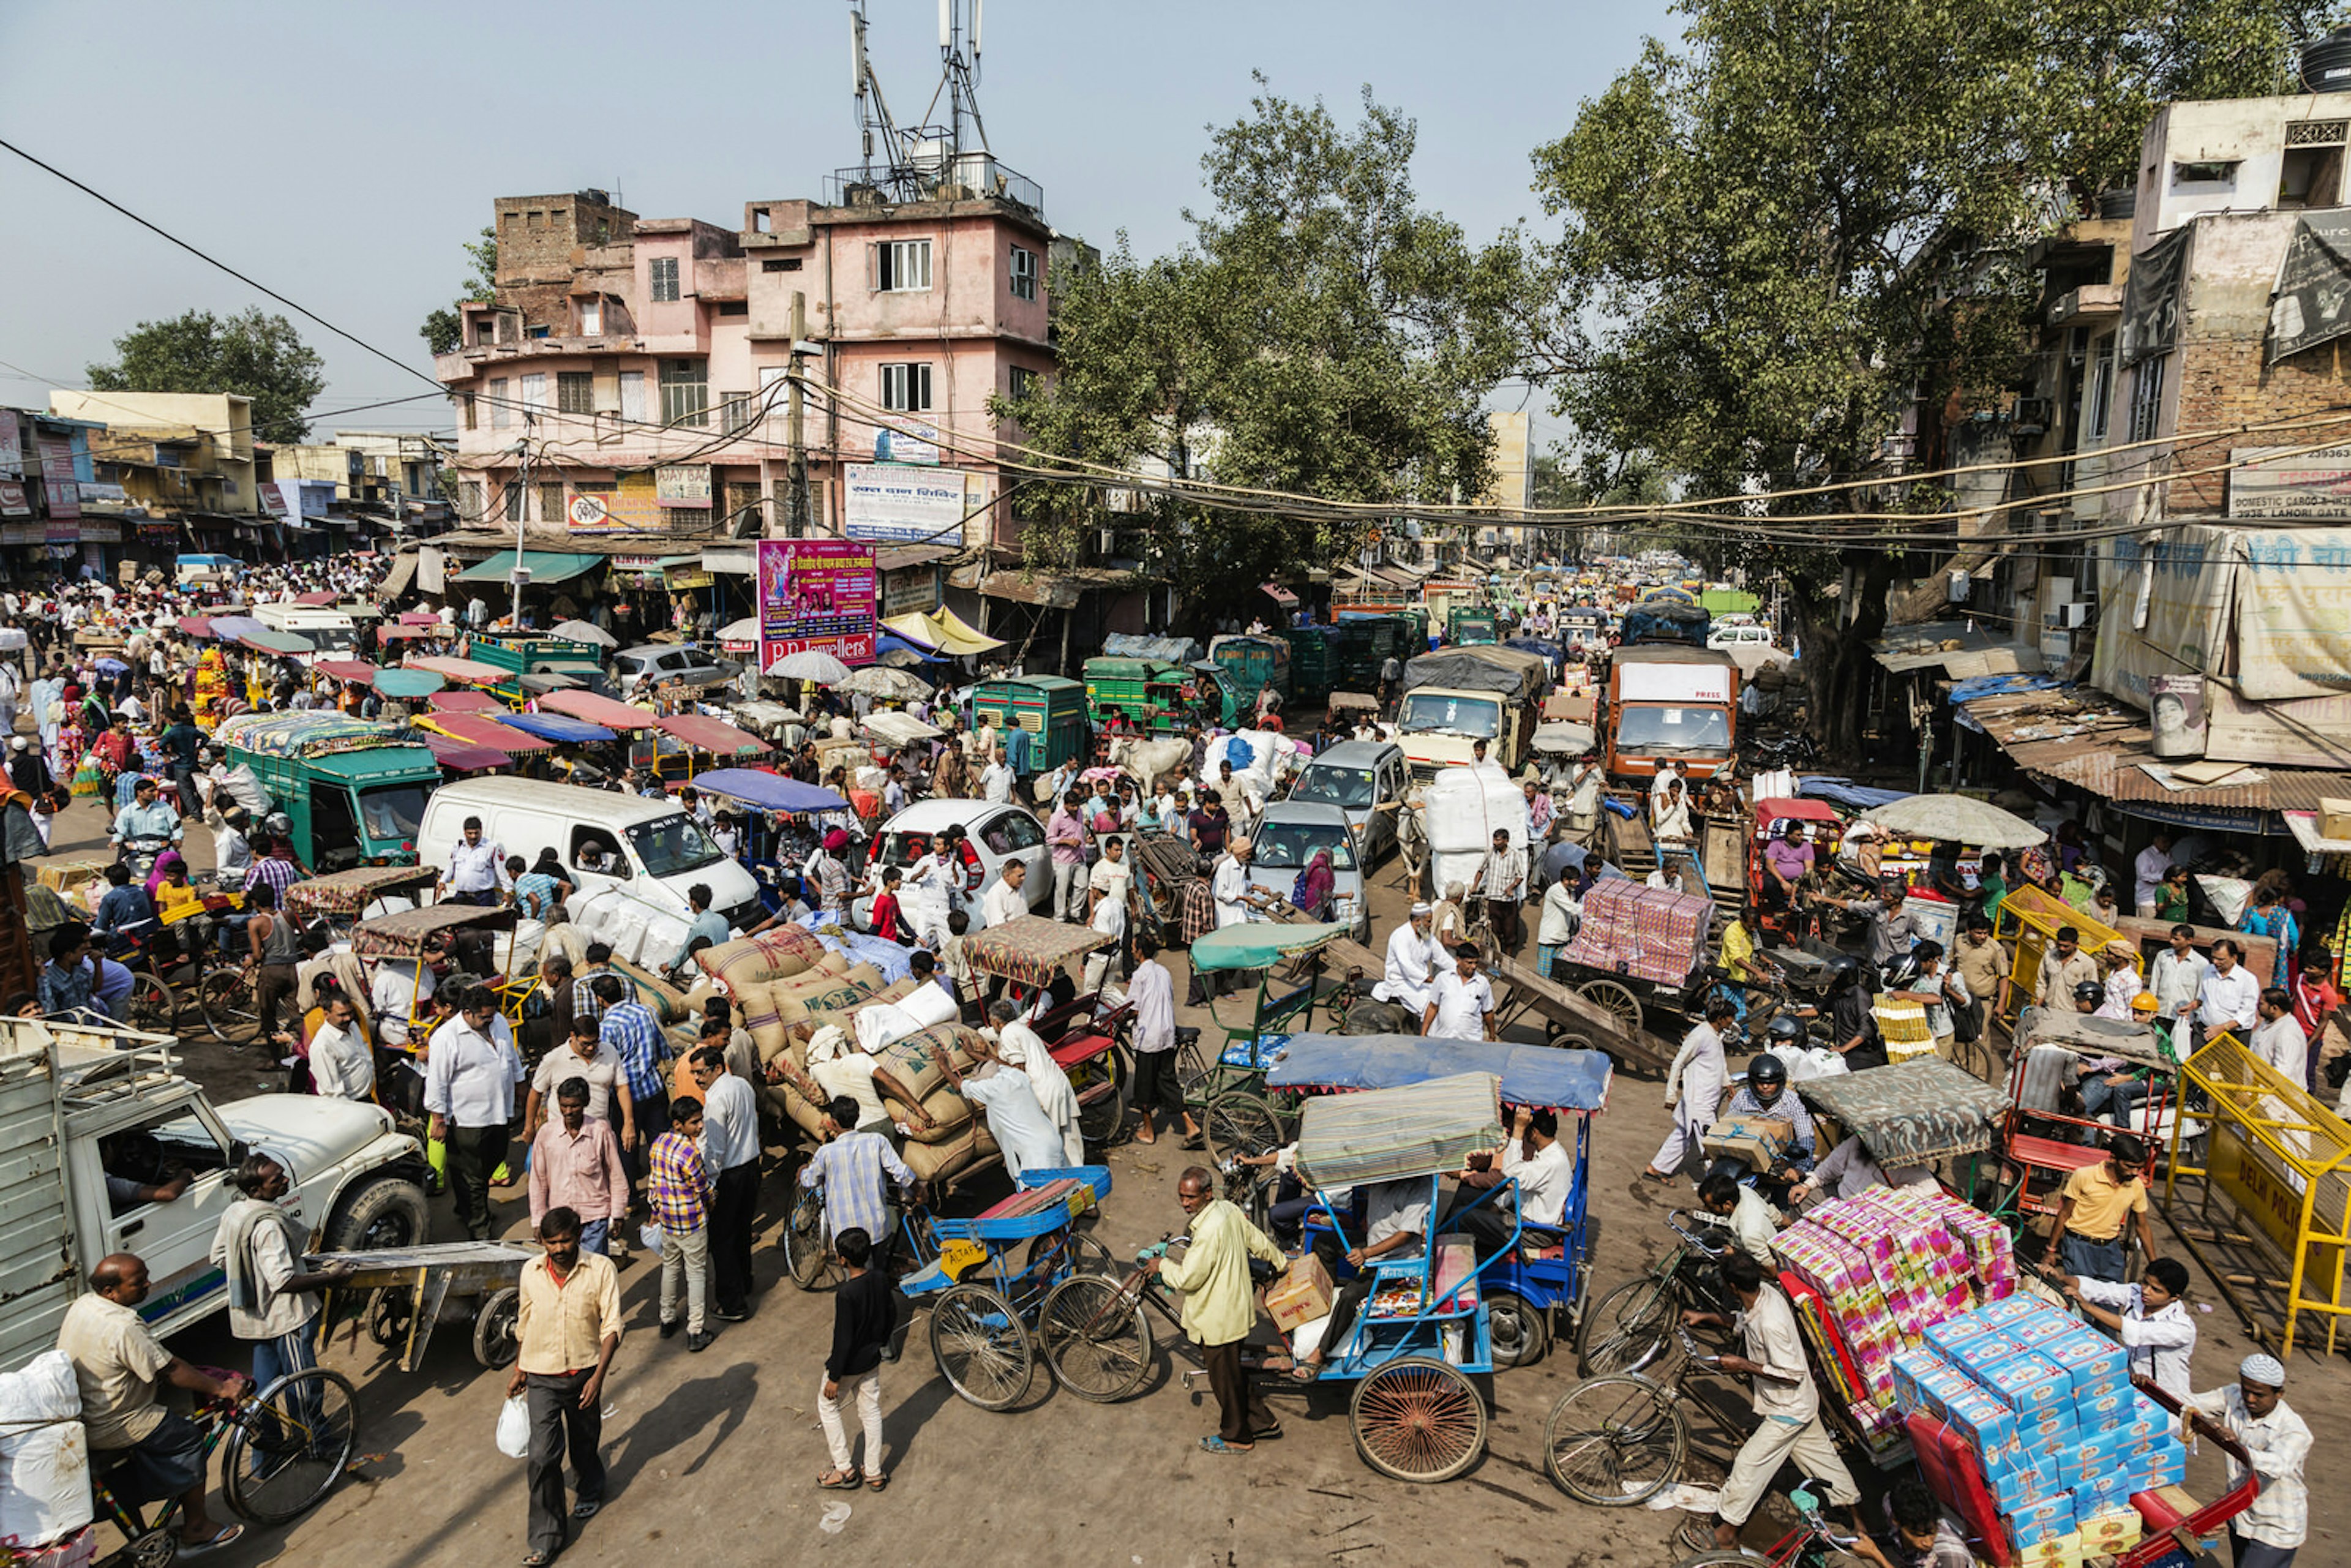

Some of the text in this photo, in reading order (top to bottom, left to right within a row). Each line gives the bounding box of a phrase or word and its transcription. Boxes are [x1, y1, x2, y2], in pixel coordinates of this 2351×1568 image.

[658, 469, 684, 482] AJAY
[917, 487, 959, 499] शिविर
[2236, 498, 2282, 508] DOMESTIC
[2286, 497, 2317, 506] CARGO
[2271, 508, 2312, 517] LAHORI
[2317, 508, 2347, 518] GATE
[2239, 1160, 2301, 1232] DELHI POLIC
